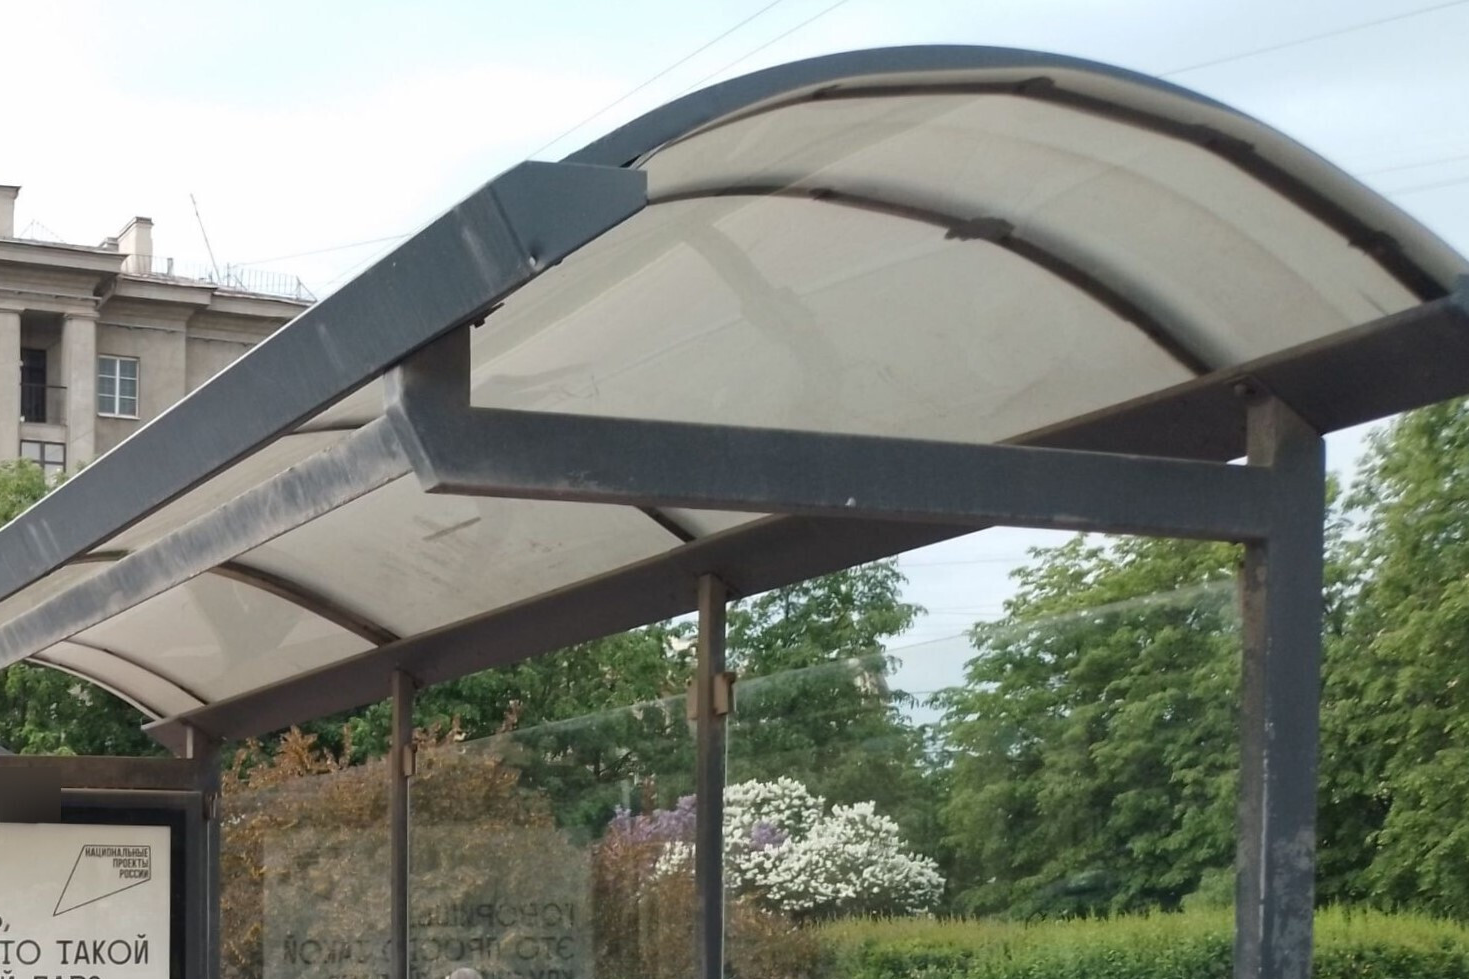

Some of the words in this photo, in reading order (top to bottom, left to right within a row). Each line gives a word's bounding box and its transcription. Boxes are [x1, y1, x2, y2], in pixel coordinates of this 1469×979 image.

[85, 848, 148, 858] НАЦИОНАЛЬНЫЕ
[113, 858, 148, 868] ПРОЕКТЫ
[119, 869, 148, 878] РОССИИ
[57, 934, 149, 966] ТАКОЙ
